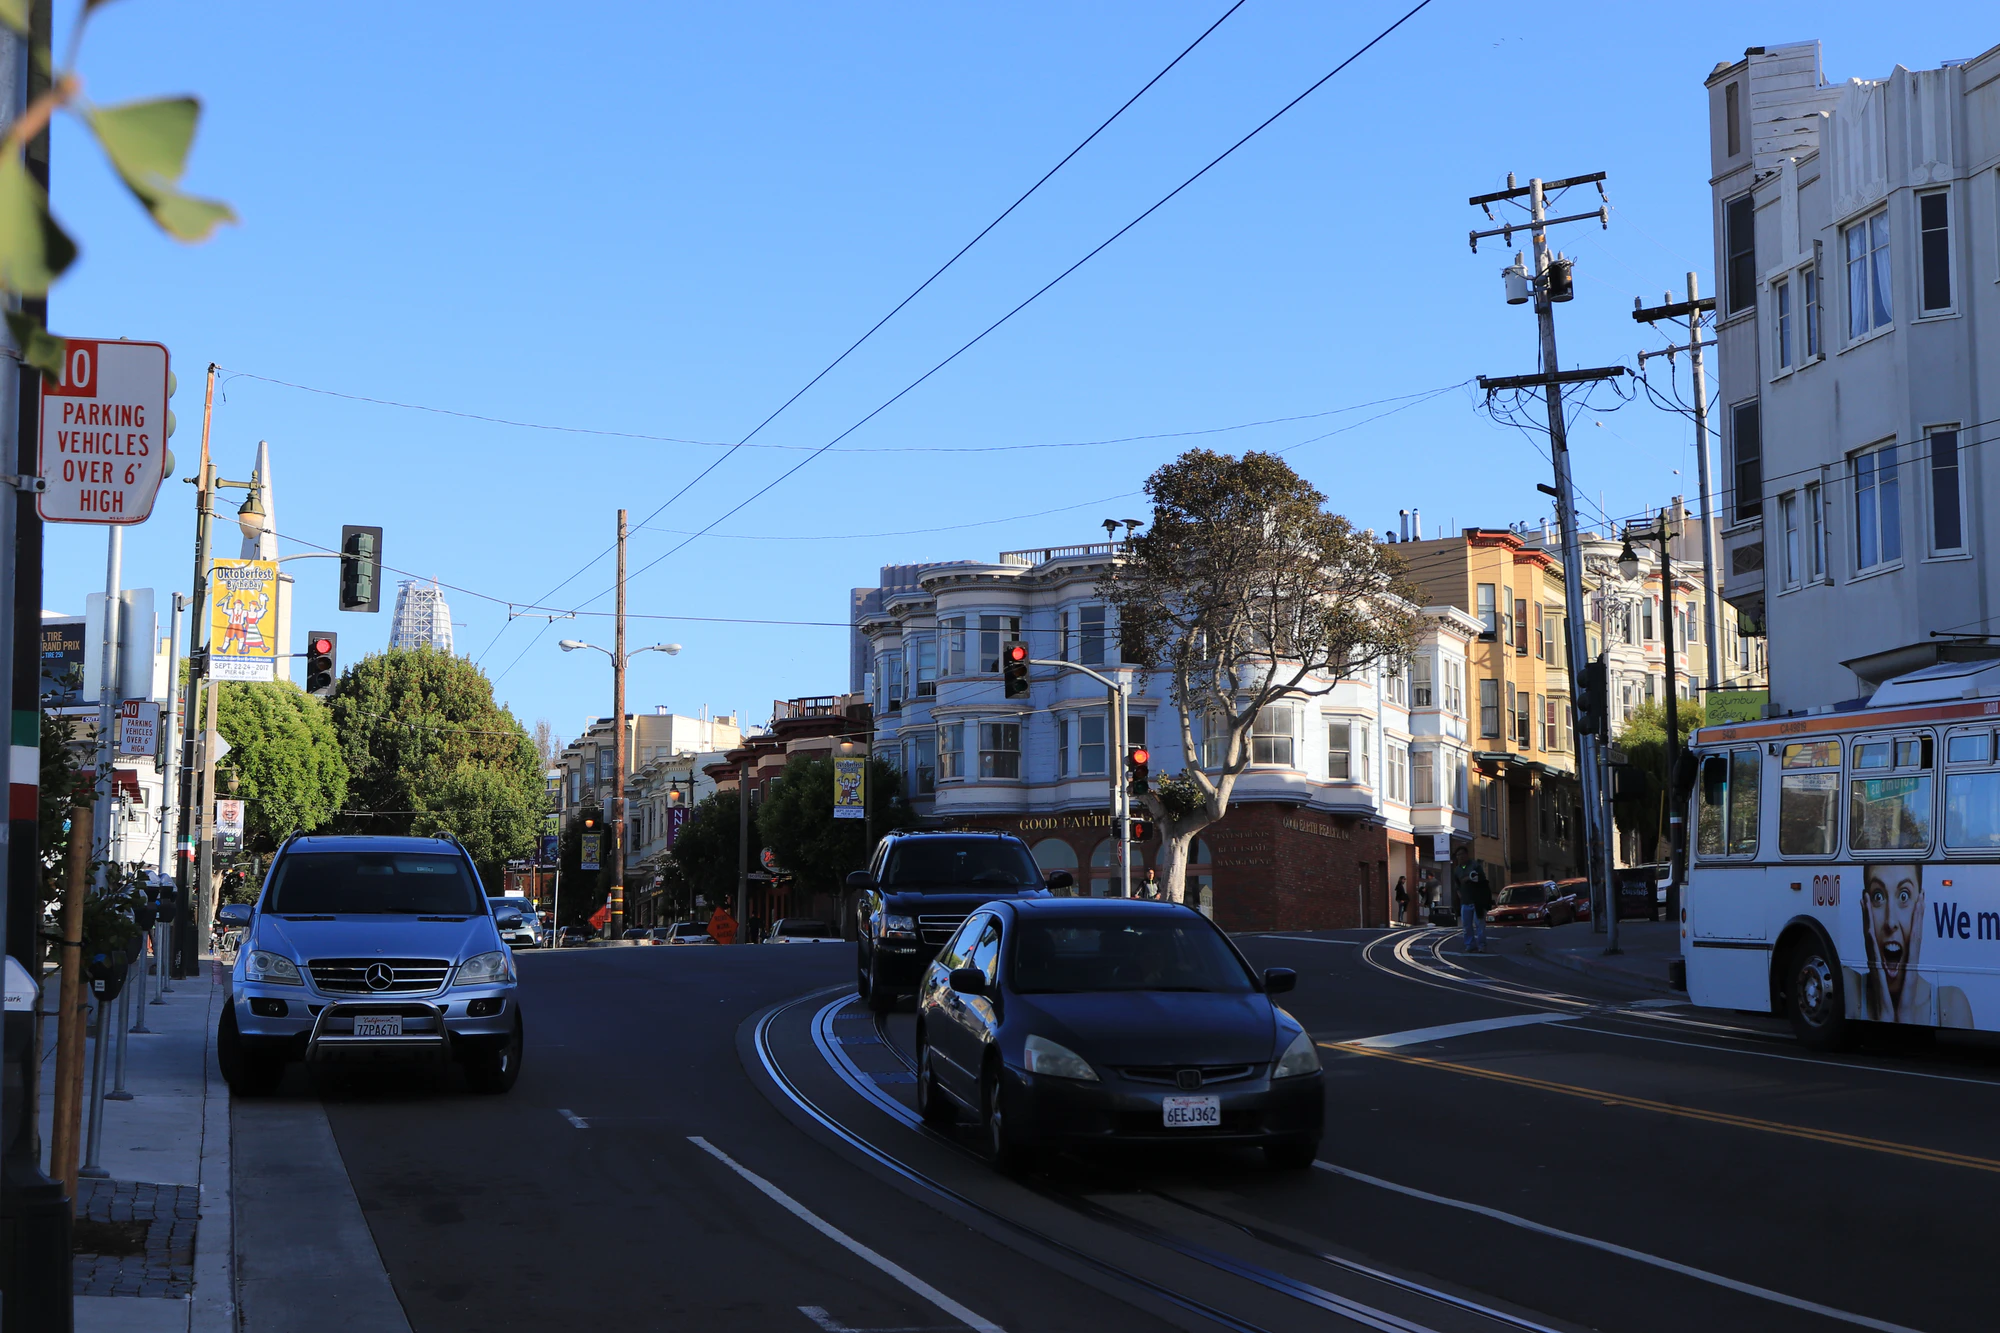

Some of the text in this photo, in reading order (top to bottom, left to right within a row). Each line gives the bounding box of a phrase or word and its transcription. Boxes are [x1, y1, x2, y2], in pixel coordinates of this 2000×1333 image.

[63, 402, 145, 428] PARKING
[57, 431, 149, 457] VEHICLES
[63, 459, 142, 485] OVER 6'
[80, 490, 123, 513] HIGH
[217, 567, 272, 579] Oktoberfest
[47, 631, 62, 641] TIRE
[42, 640, 80, 652] RAND PRIX
[1708, 696, 1758, 706] Columbus
[124, 703, 137, 716] NO
[127, 719, 152, 728] PARKING
[125, 728, 153, 737] VEHICLES
[126, 736, 142, 744] OVER
[1019, 815, 1111, 831] GOOD EARTH
[1933, 902, 1971, 940] We
[357, 1024, 399, 1036] 7ZPA670
[1167, 1106, 1217, 1123] 6EEJ362
